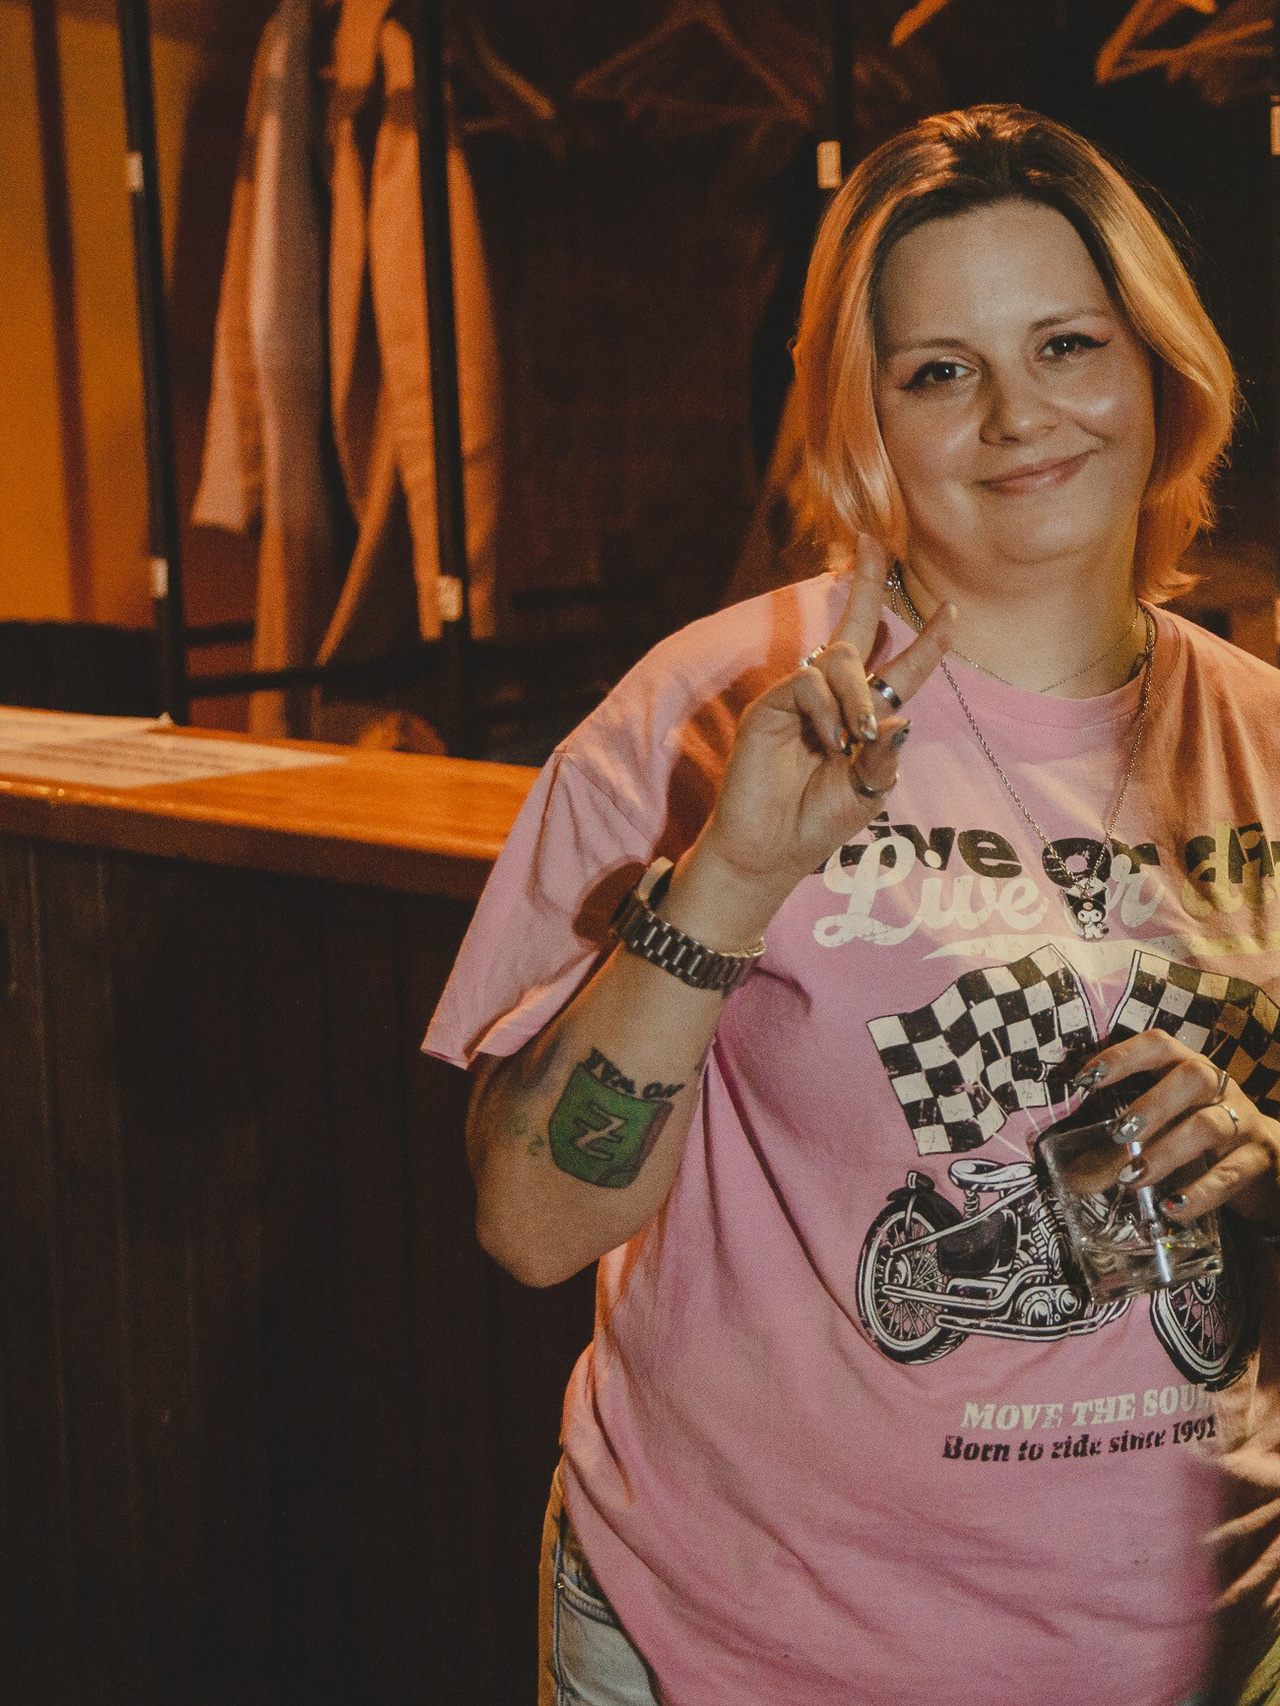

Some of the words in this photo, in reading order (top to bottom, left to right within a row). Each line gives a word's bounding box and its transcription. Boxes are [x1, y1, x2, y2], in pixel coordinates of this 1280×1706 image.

[812, 835, 1048, 948] Live
[961, 1401, 1064, 1431] MOVE
[1071, 1393, 1136, 1427] THE
[942, 1435, 1011, 1462] Born
[1018, 1440, 1043, 1461] to
[1051, 1434, 1102, 1459] ride
[1109, 1429, 1166, 1454] since
